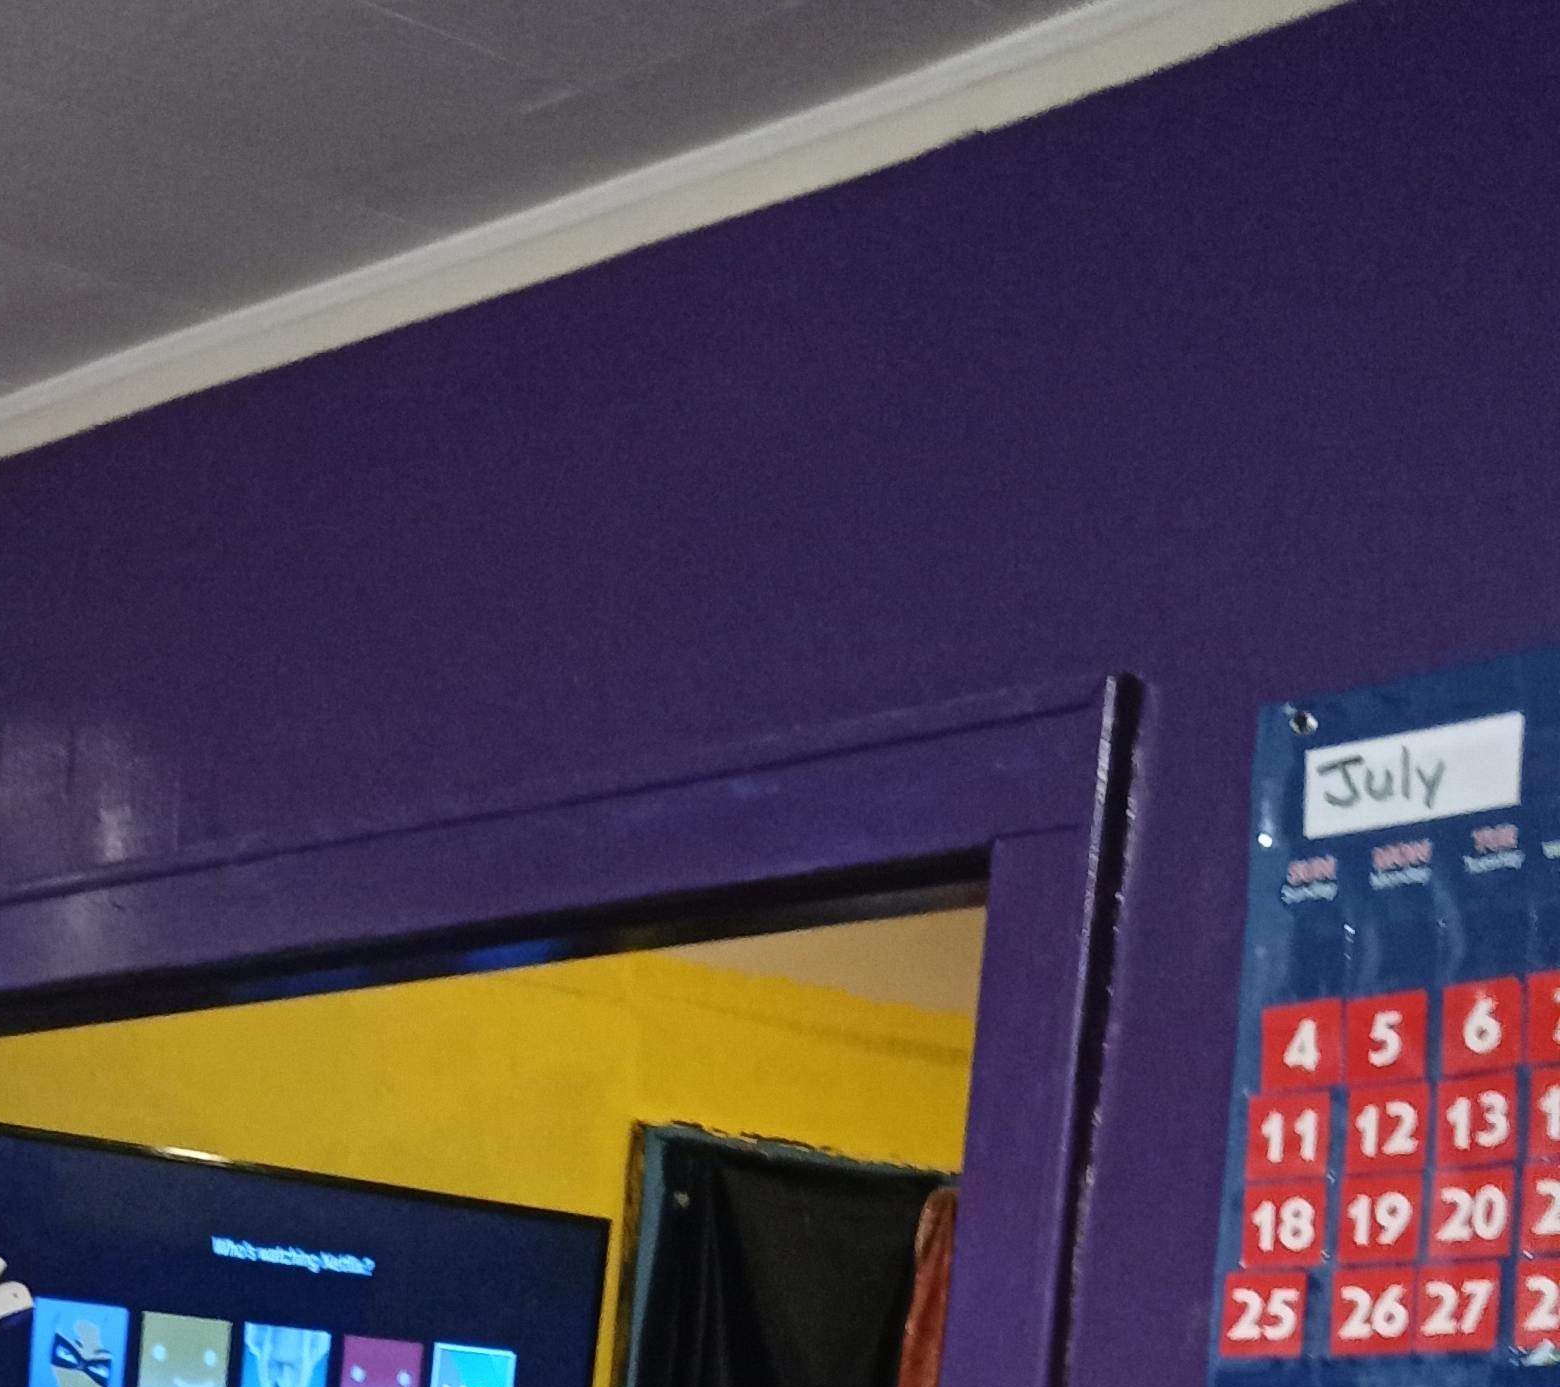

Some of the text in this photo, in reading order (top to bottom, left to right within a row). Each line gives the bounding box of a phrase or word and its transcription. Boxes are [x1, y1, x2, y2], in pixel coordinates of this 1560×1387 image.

[1317, 745, 1445, 809] July
[1283, 1018, 1321, 1072] 4
[1367, 1010, 1403, 1068] 5
[1463, 995, 1502, 1054] 6
[1261, 1084, 1560, 1163] 11 12 13 1
[1251, 1178, 1560, 1252] 18 19 20 2
[1226, 1275, 1560, 1341] 25 26 27 2
